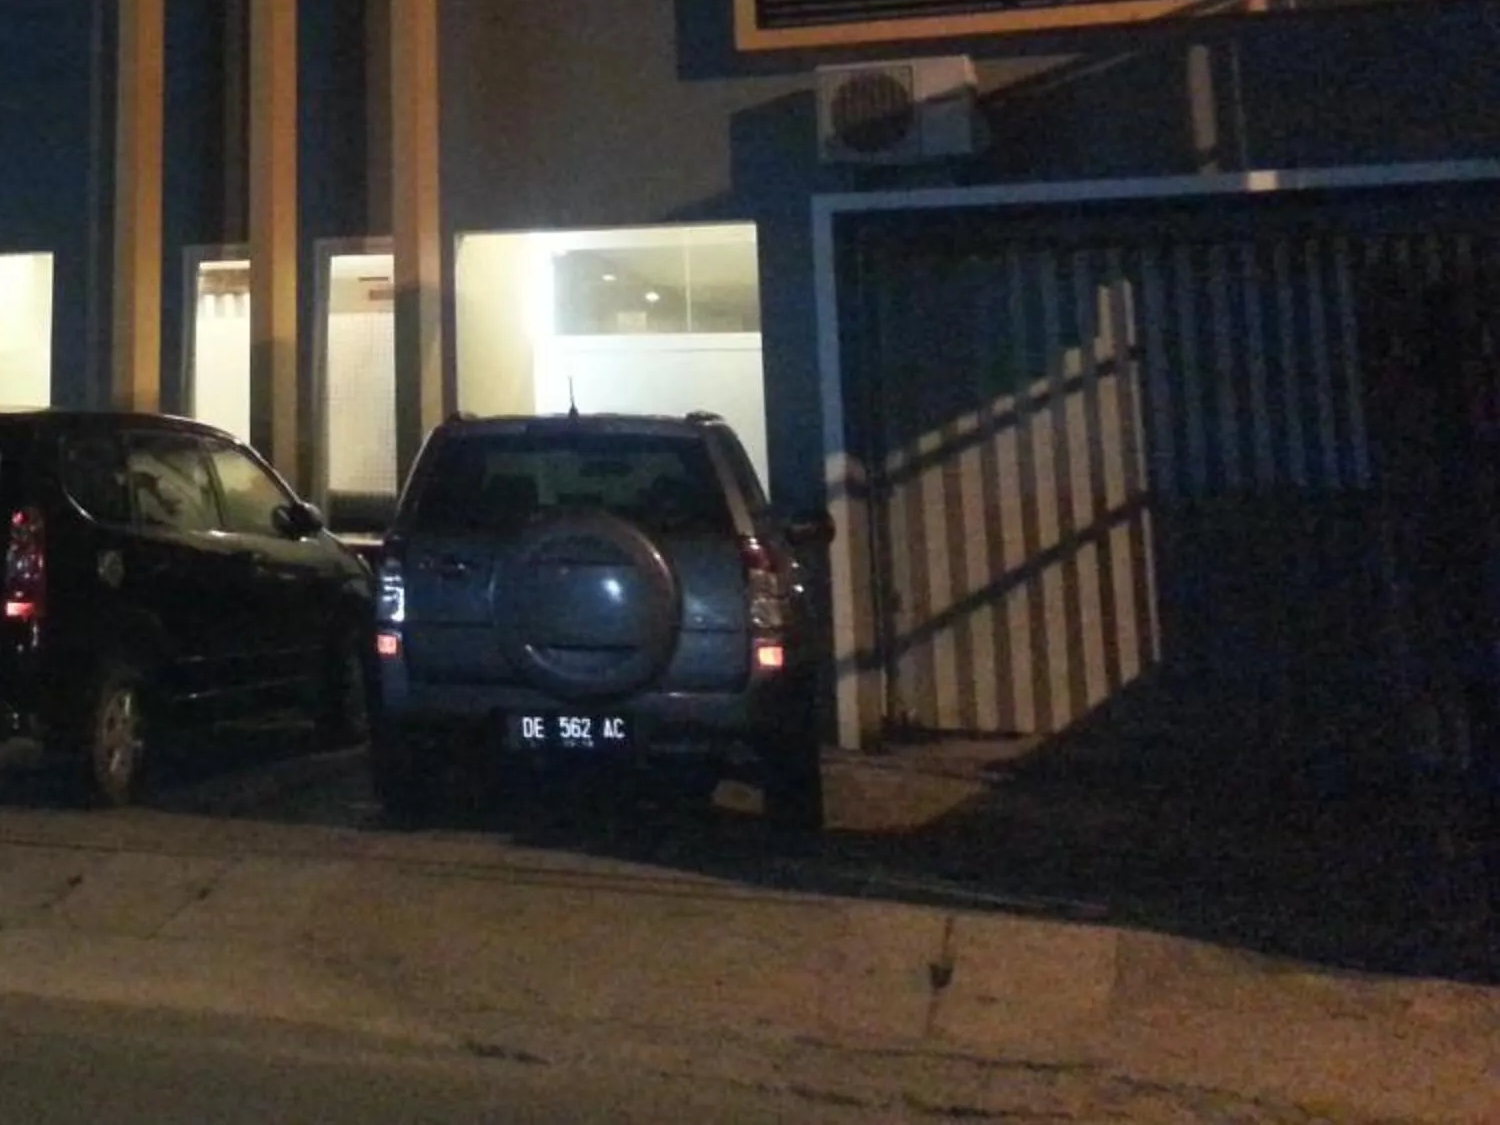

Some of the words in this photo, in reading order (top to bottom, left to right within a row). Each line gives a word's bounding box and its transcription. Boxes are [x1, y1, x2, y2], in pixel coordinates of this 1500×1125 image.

[522, 716, 545, 738] DE
[558, 716, 592, 738] 562
[603, 717, 626, 738] AC
